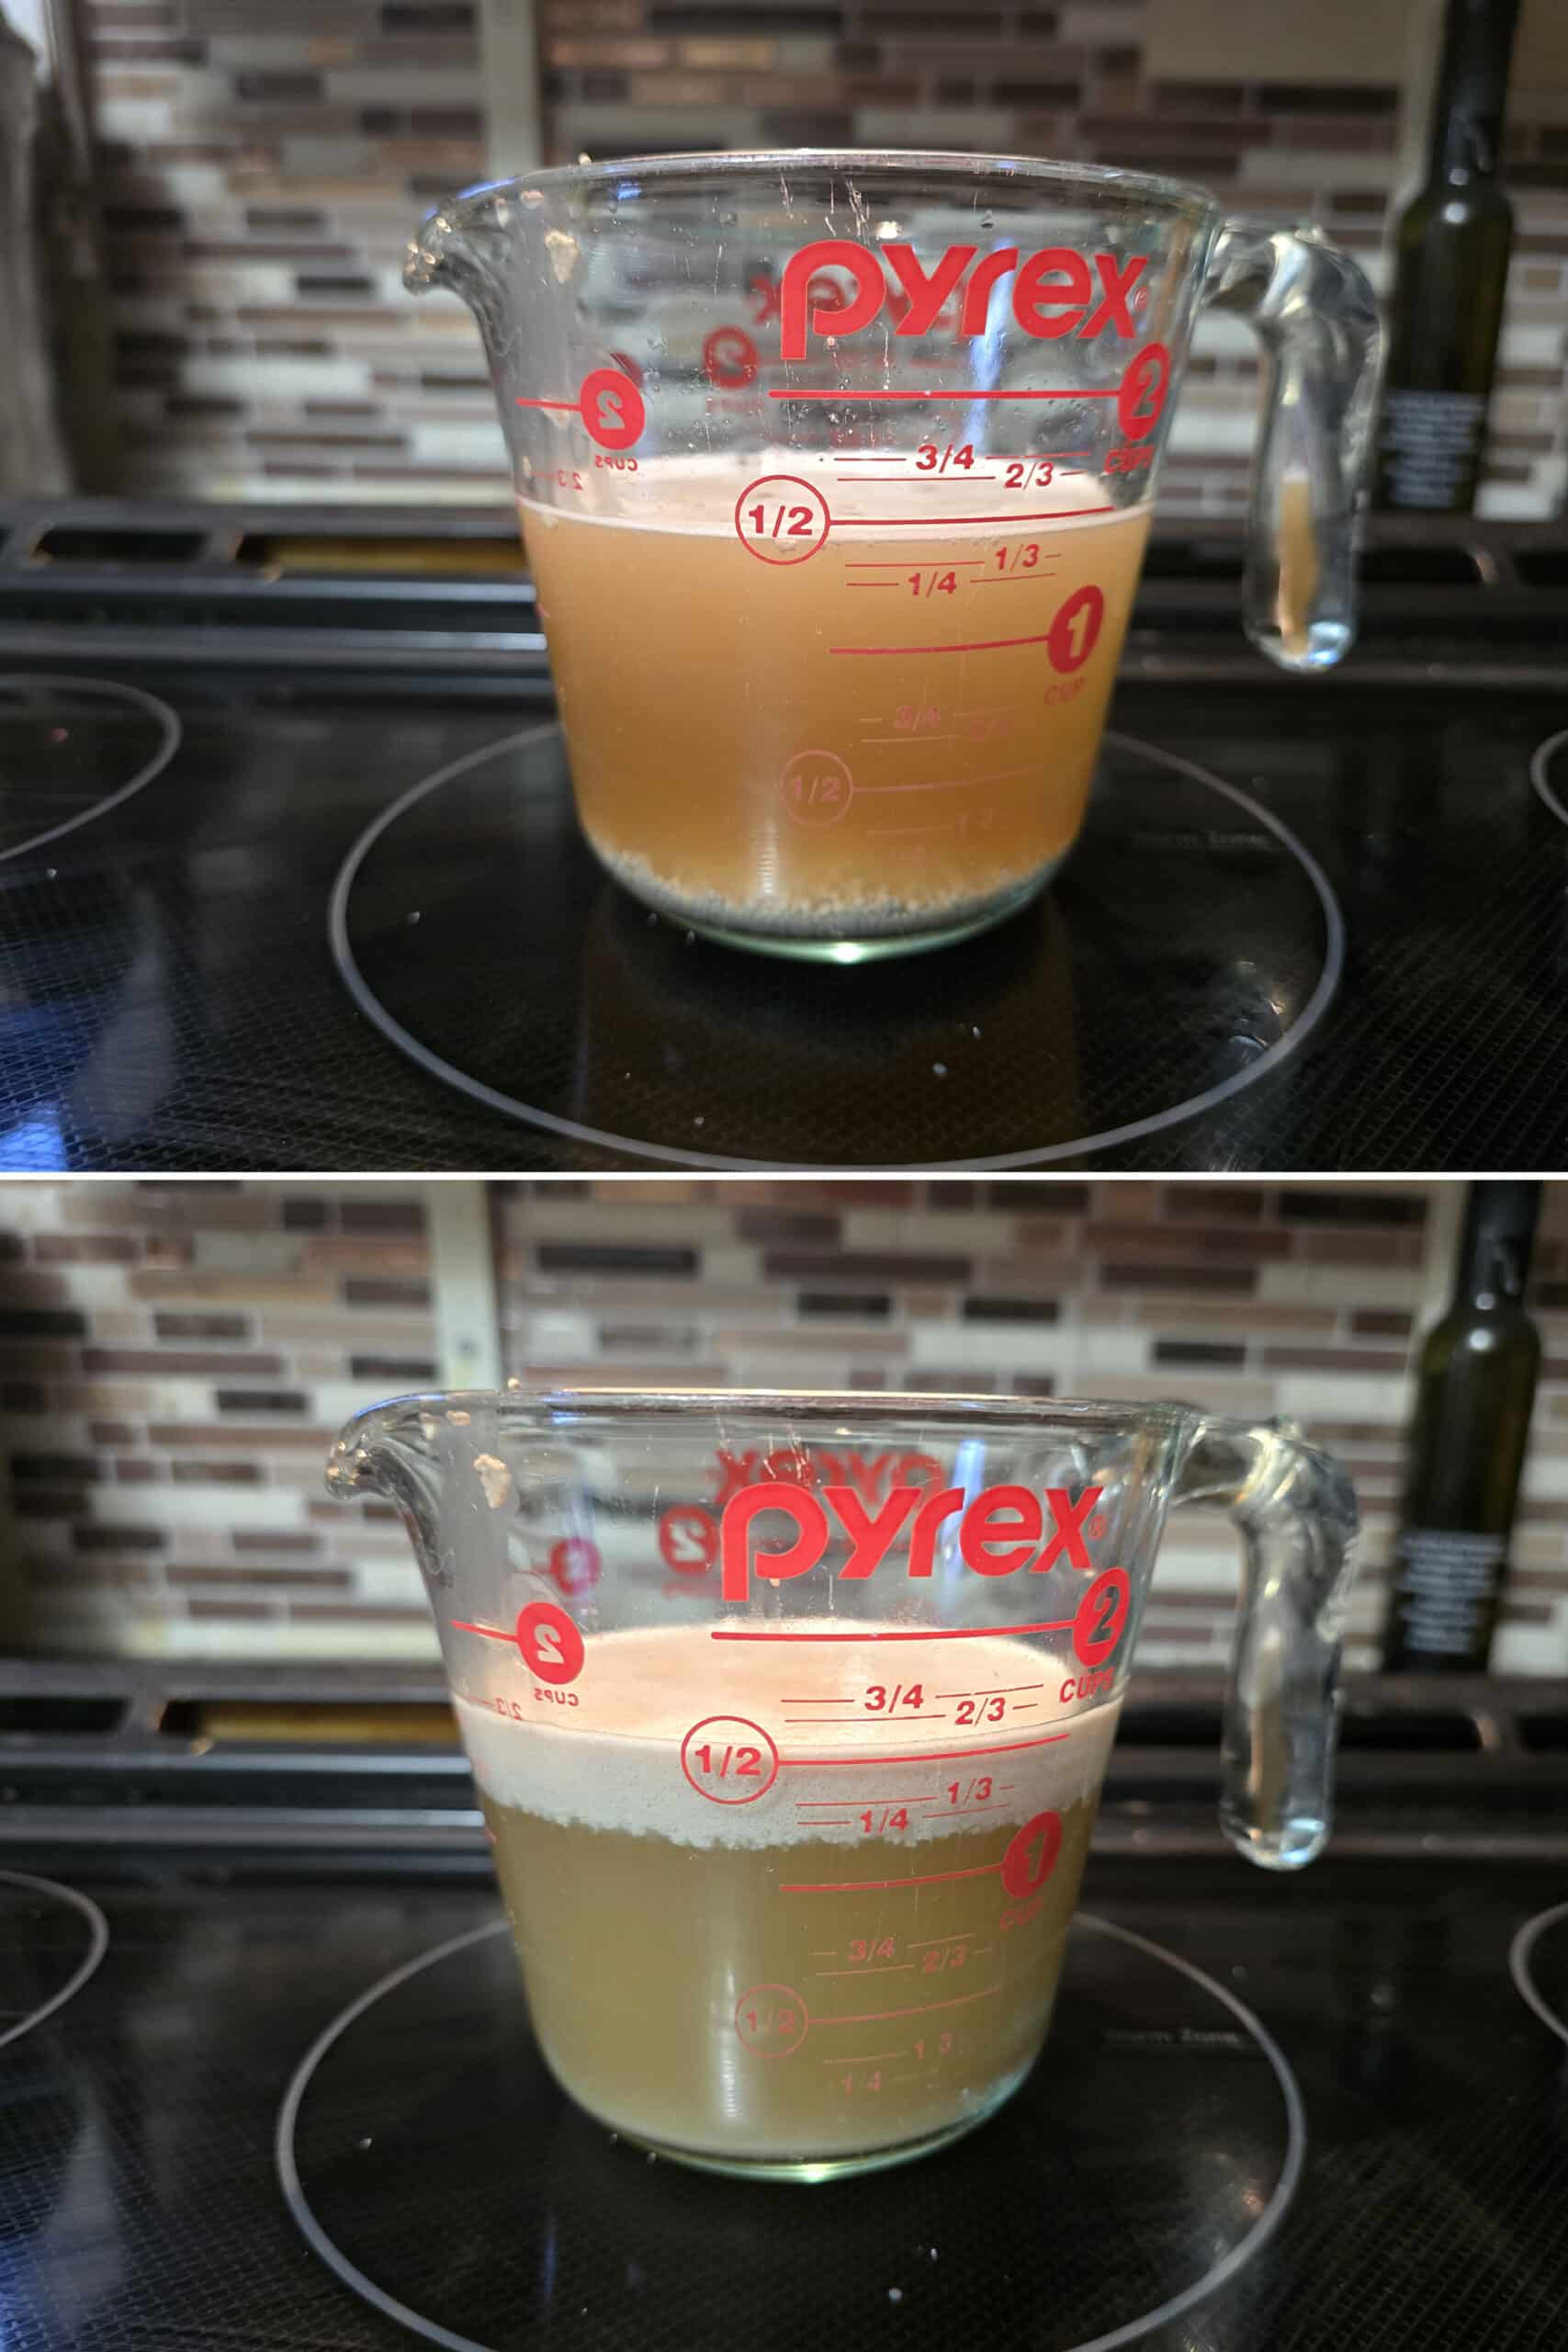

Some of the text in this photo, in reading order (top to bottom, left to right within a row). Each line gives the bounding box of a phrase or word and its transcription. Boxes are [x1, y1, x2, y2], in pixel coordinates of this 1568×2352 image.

[780, 240, 1148, 360] pyrex
[915, 444, 976, 473] 3/4
[1004, 462, 1054, 490] 2/3
[749, 504, 814, 537] 1/2
[995, 543, 1040, 571] 1/3
[908, 571, 958, 598] 1/4
[791, 776, 841, 806] 1/2
[720, 1482, 1104, 1602] pyrex
[864, 1684, 924, 1713] 3/4
[1059, 1666, 1115, 1703] CUPS
[954, 1698, 1006, 1727] 2/3
[694, 1745, 762, 1778] 1/2
[947, 1777, 993, 1805] 1/3
[860, 1808, 909, 1835] 1/4
[848, 1937, 897, 1963] 3/4
[922, 1945, 968, 1975] 2/3
[745, 2008, 795, 2035] 1/2
[914, 2032, 953, 2059] 13
[842, 2070, 883, 2096] 14
